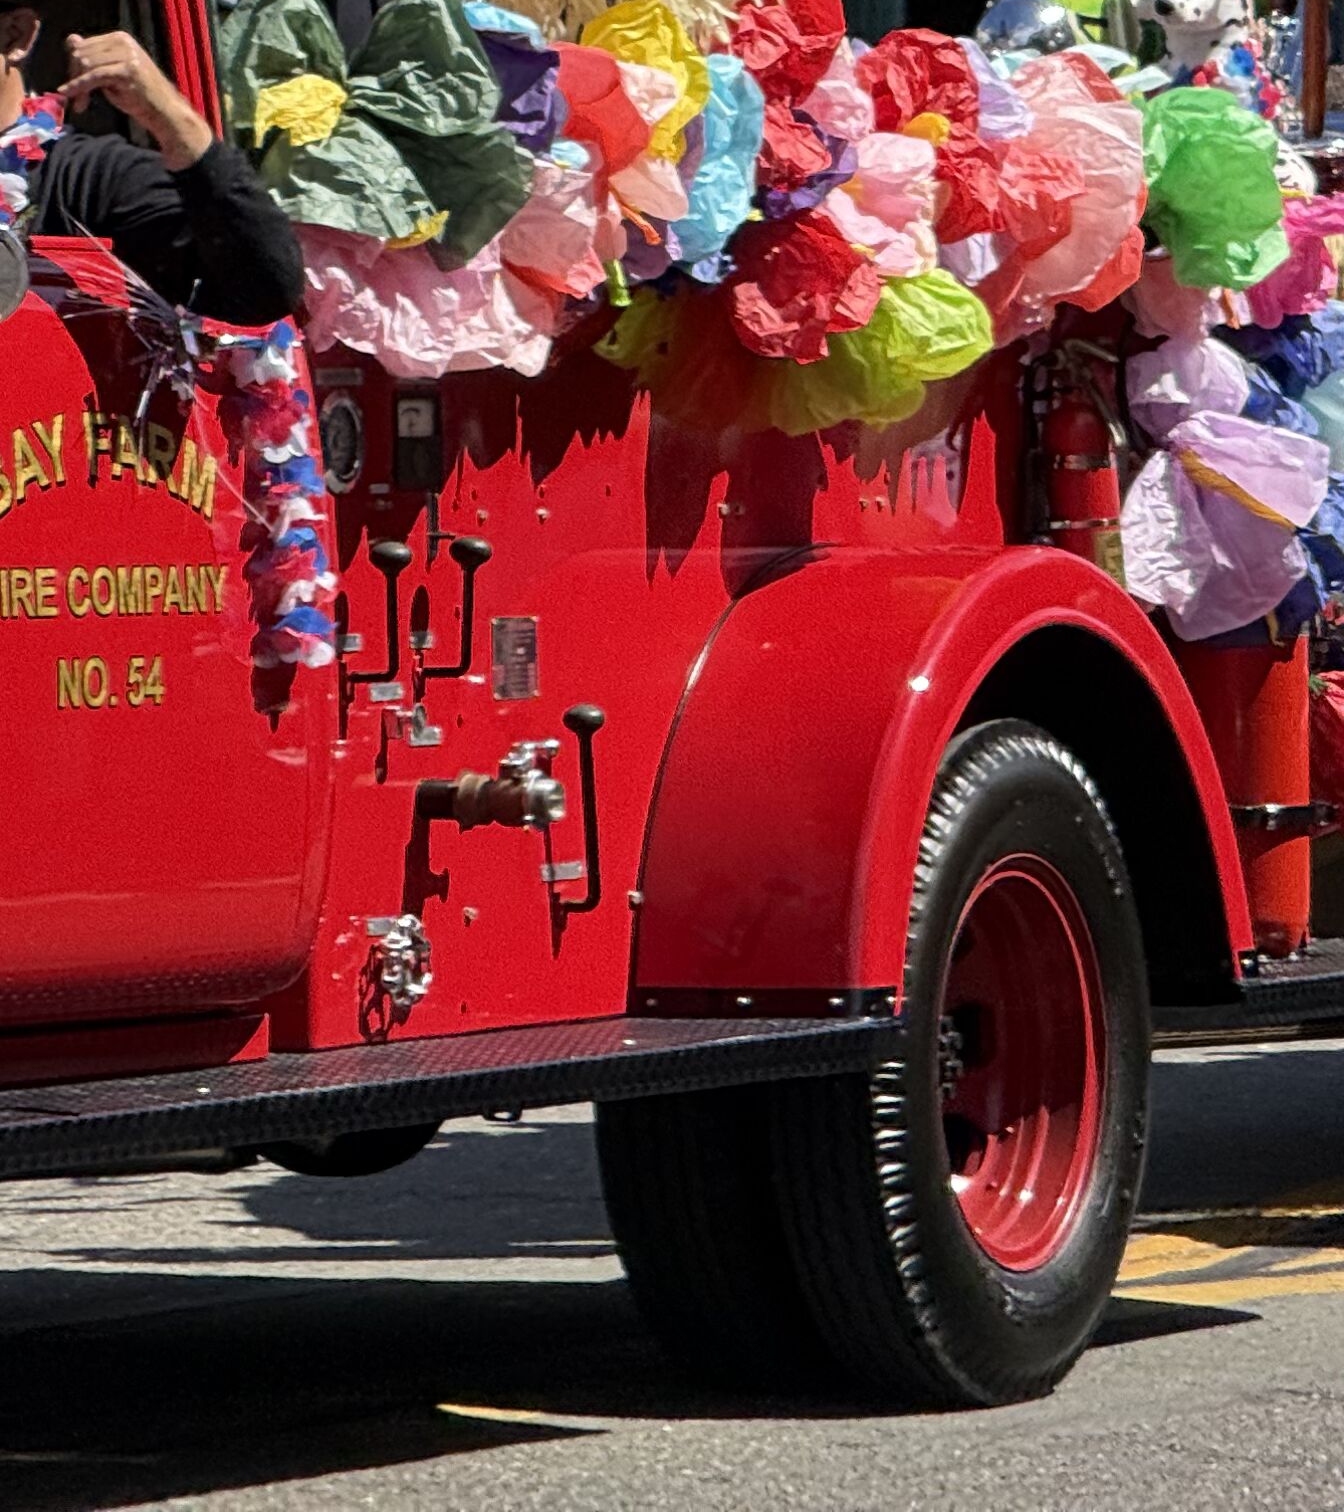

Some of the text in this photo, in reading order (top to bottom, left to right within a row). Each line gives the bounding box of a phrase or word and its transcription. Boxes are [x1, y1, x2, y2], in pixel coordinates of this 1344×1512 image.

[81, 410, 218, 521] FARM
[65, 563, 230, 618] COMPANY
[56, 655, 167, 710] NO. 54
